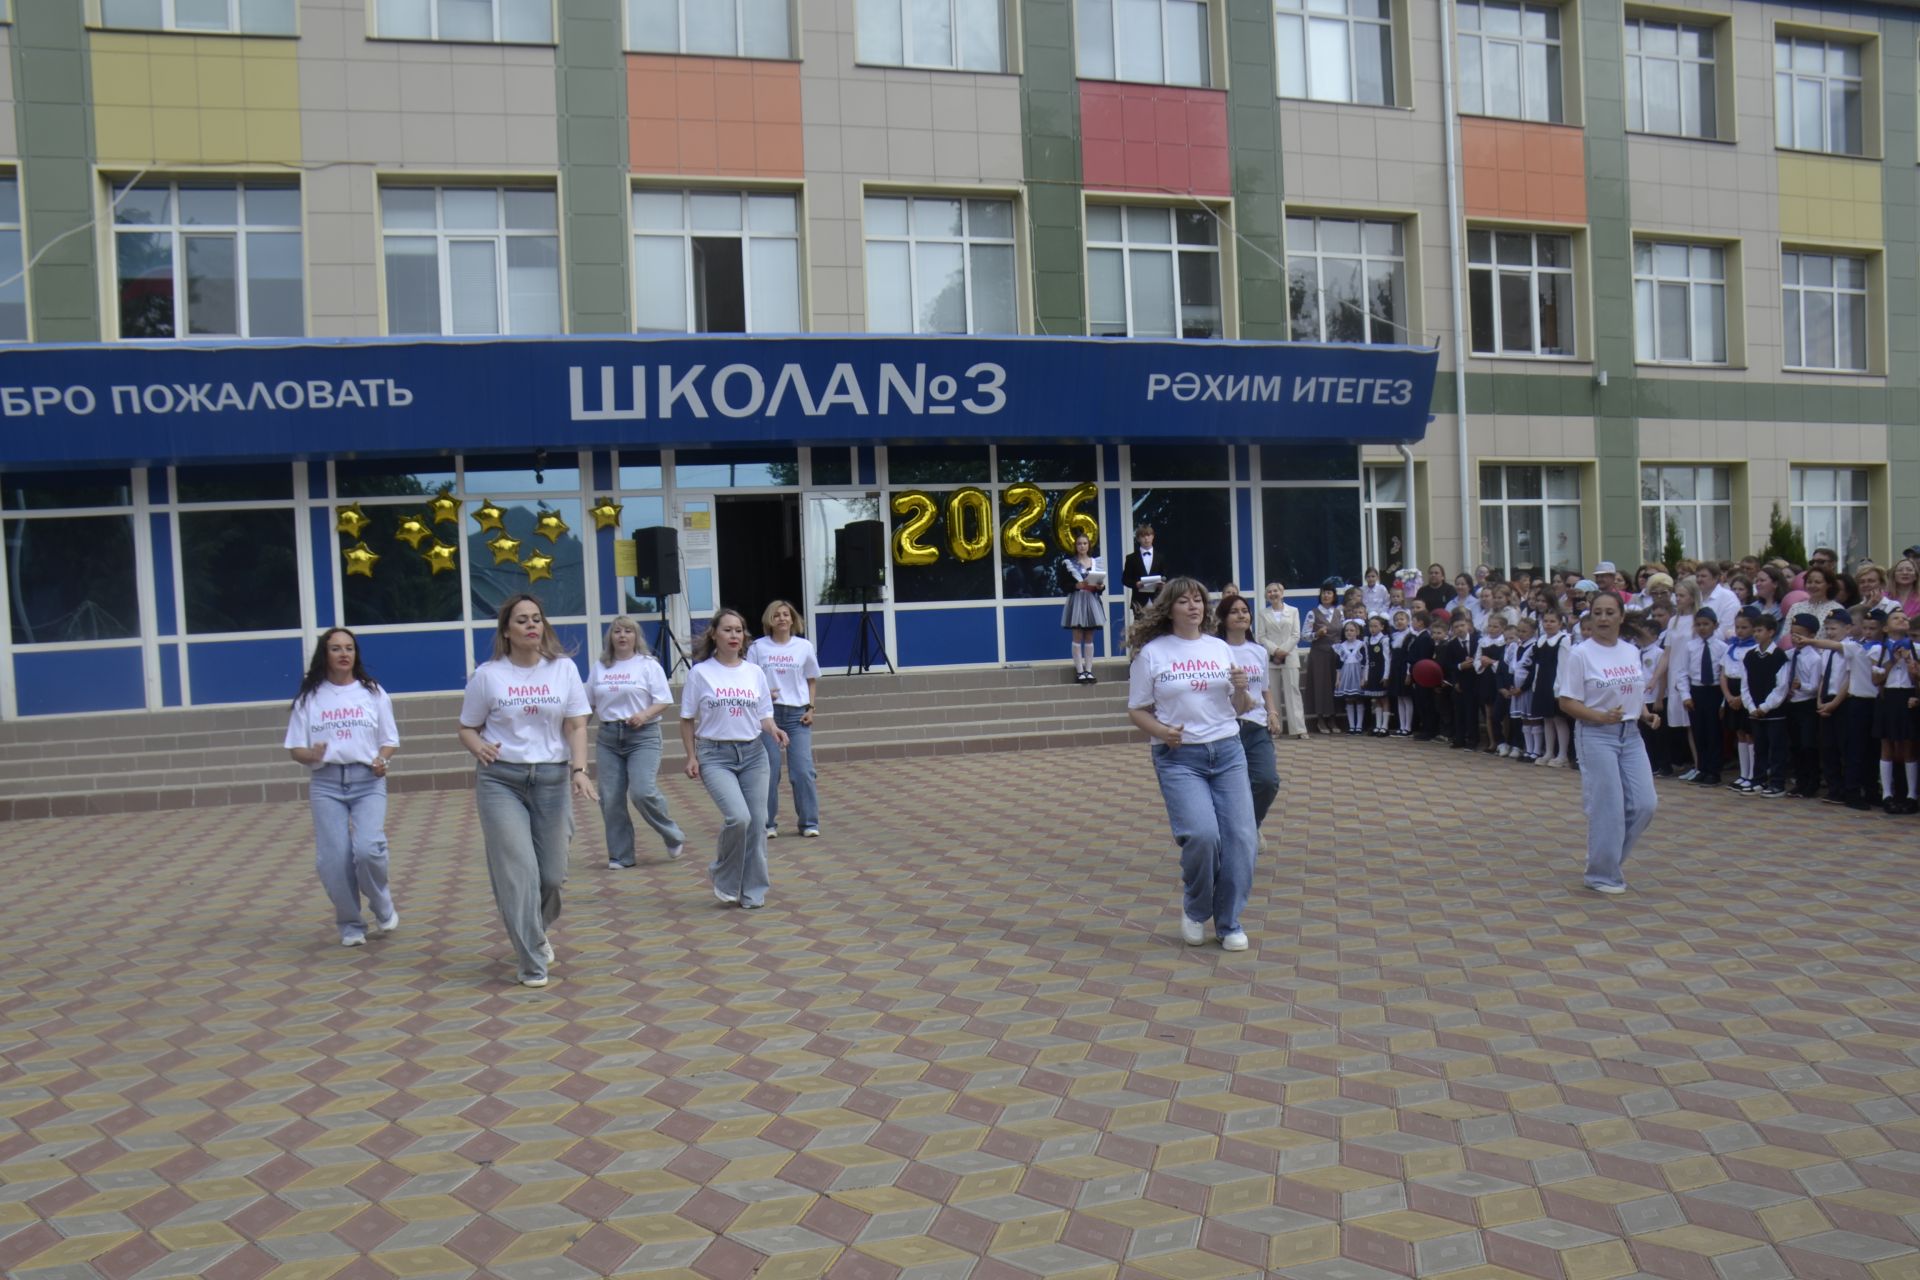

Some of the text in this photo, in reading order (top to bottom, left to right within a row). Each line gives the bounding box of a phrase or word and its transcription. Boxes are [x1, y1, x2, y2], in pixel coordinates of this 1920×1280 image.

[1147, 372, 1413, 405] РӘХИМ ИТЕГЕЗ
[0, 379, 413, 416] БРО ПОЖАЛОВАТЬ
[891, 481, 1099, 566] 2026
[1172, 659, 1220, 673] МАМА
[1242, 665, 1261, 674] МА
[508, 684, 550, 697] МАМА
[1191, 679, 1208, 692] 9А
[1620, 684, 1633, 695] 9А
[716, 687, 755, 699] МАМА
[498, 696, 562, 707] ВЫПУСКНИКА
[321, 706, 364, 721] МАМА
[523, 705, 539, 716] 9А
[729, 707, 743, 717] 9А
[336, 729, 353, 740] 9А
